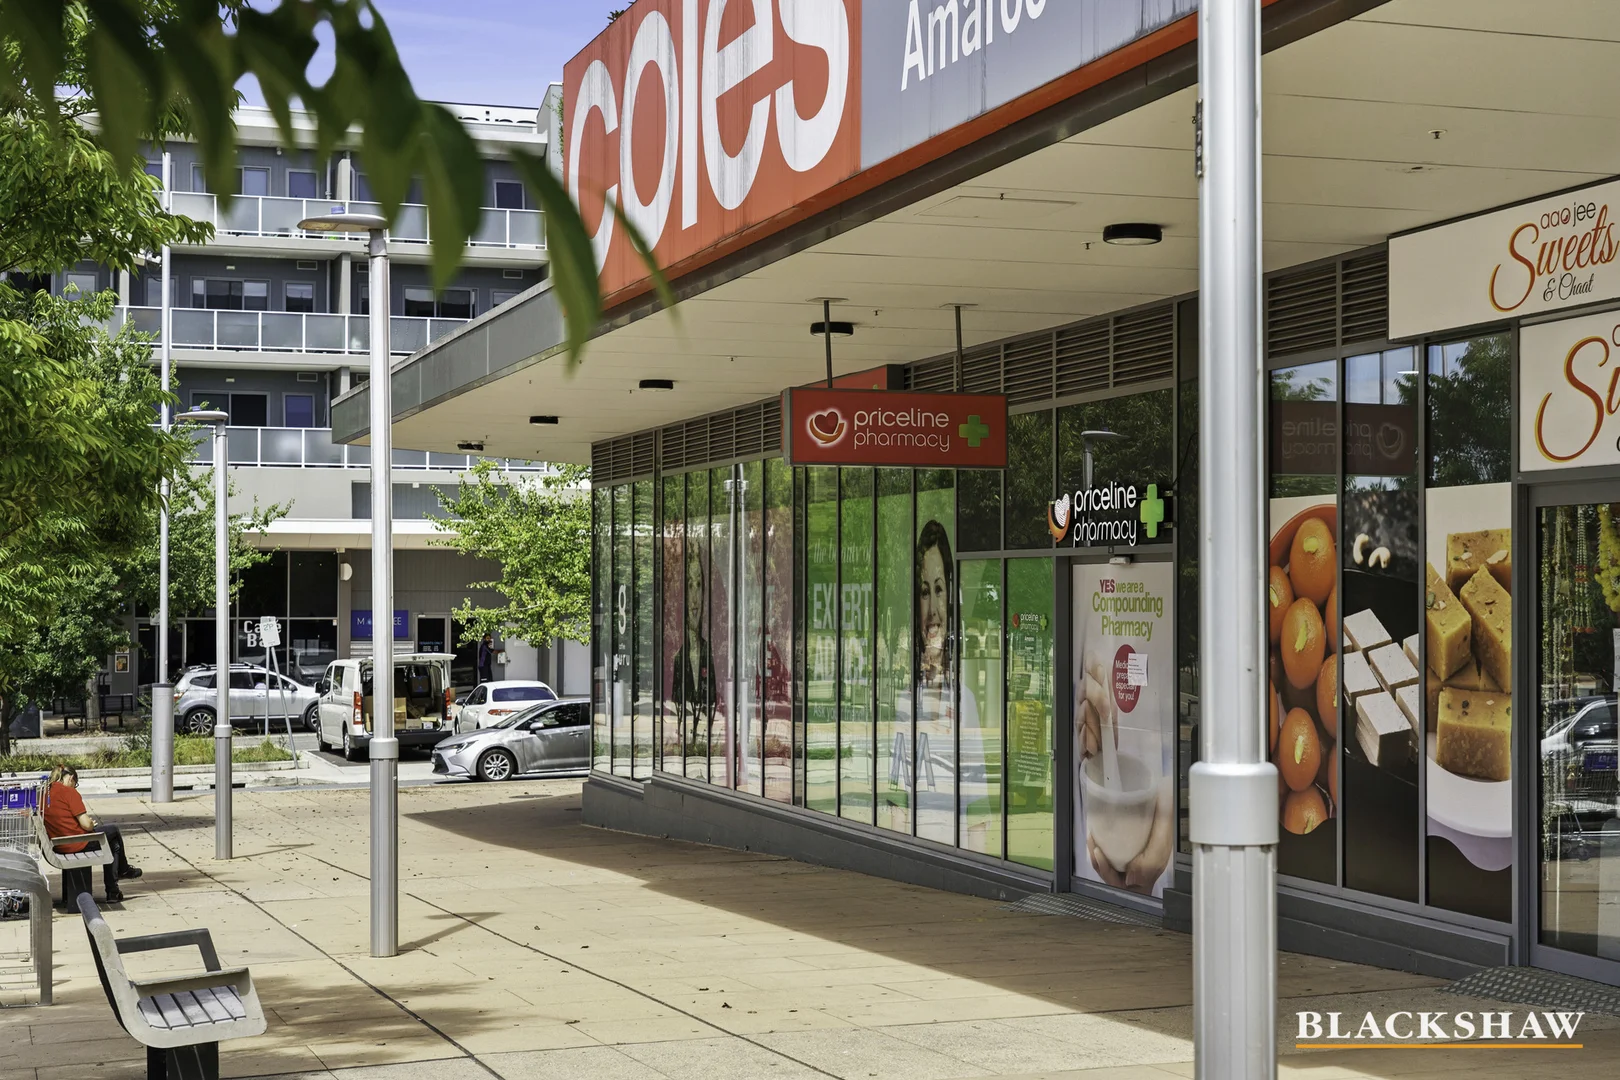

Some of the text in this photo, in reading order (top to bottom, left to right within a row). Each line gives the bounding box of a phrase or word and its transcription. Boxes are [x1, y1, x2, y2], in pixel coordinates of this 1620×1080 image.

[569, 0, 849, 278] coles
[1572, 202, 1596, 227] jee
[1489, 204, 1620, 312] Sweets
[1558, 272, 1595, 300] Chaat
[854, 408, 949, 430] priceline
[854, 428, 950, 452] pharmacy
[1074, 481, 1137, 519] priceline
[1073, 516, 1137, 548] pharmacy
[1100, 579, 1115, 593] YES
[1092, 591, 1163, 618] Compounding
[1101, 615, 1153, 642] Pharmacy
